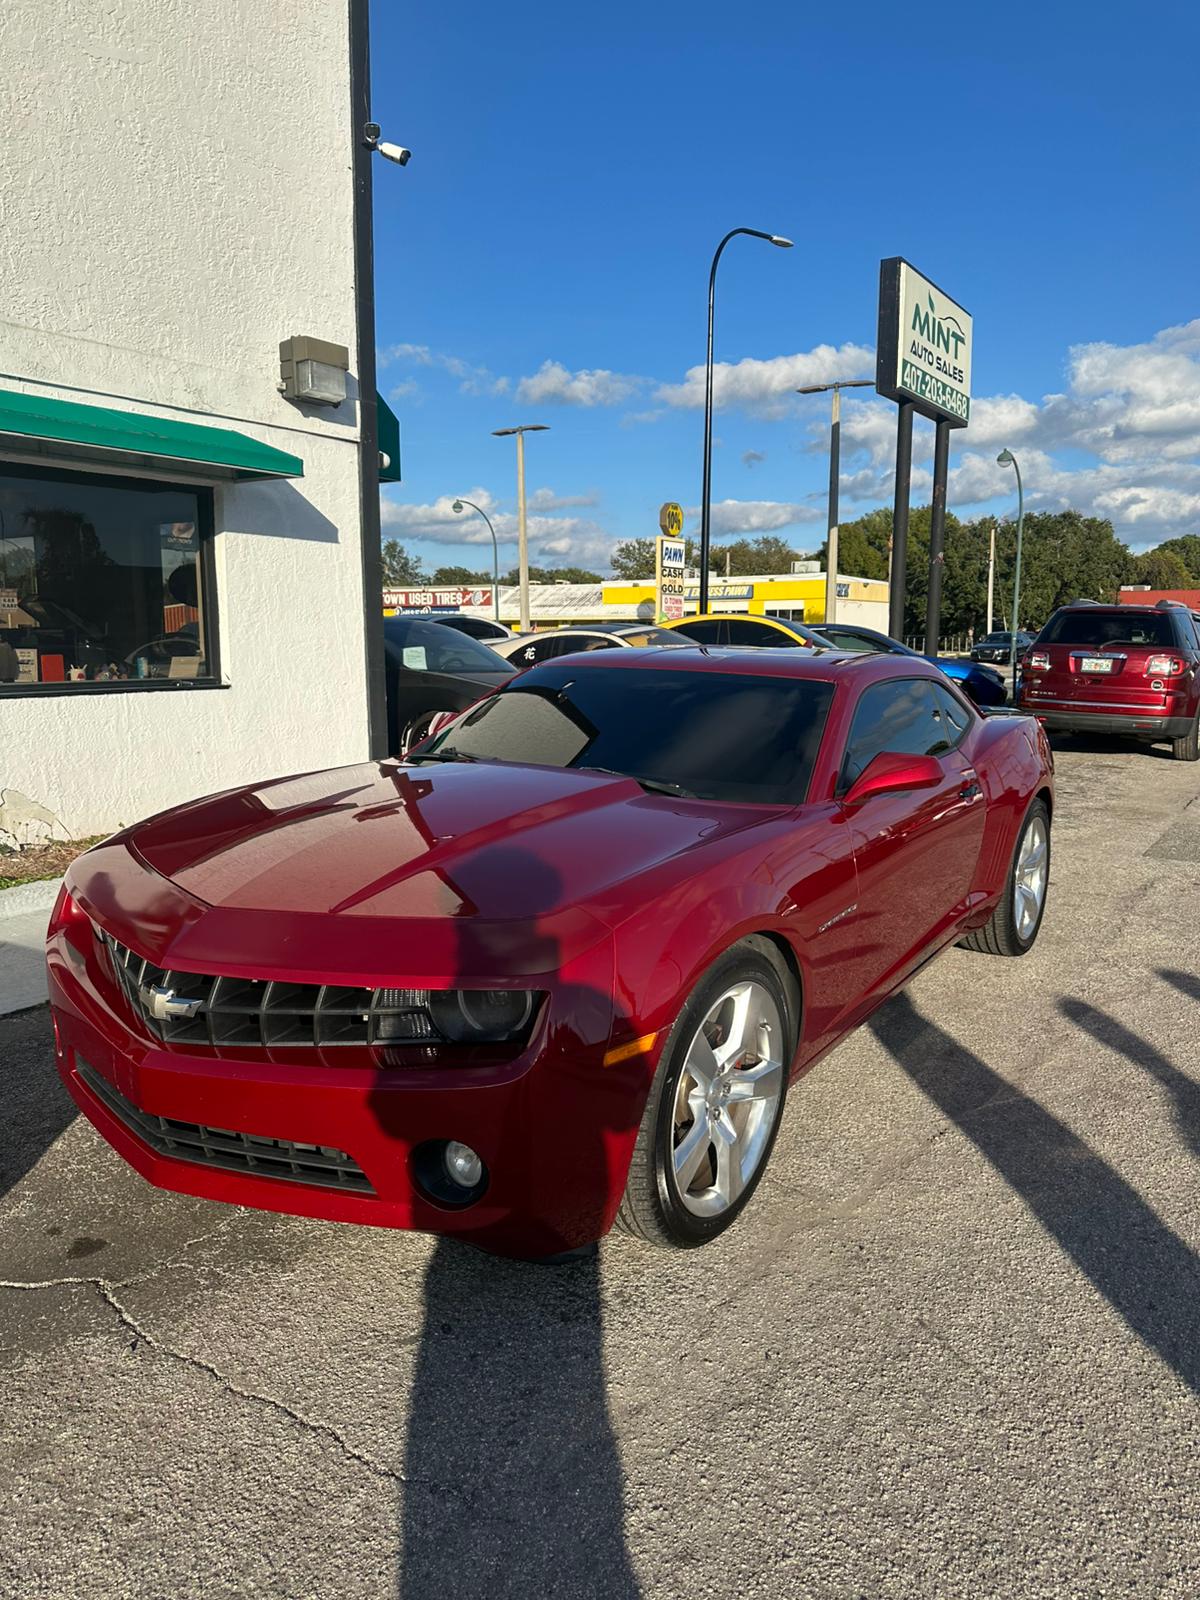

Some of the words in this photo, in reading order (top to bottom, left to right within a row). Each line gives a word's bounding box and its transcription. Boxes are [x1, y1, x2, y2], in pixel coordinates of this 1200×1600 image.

[911, 302, 966, 360] MINT
[910, 340, 934, 366] AUTO
[936, 356, 964, 384] SALES
[903, 363, 968, 418] 407-203-6468
[663, 546, 685, 562] PAWN
[661, 568, 684, 578] CASH
[661, 584, 684, 594] GOLD
[383, 592, 406, 605] OWN
[408, 592, 433, 605] USED
[434, 592, 463, 605] TIRES
